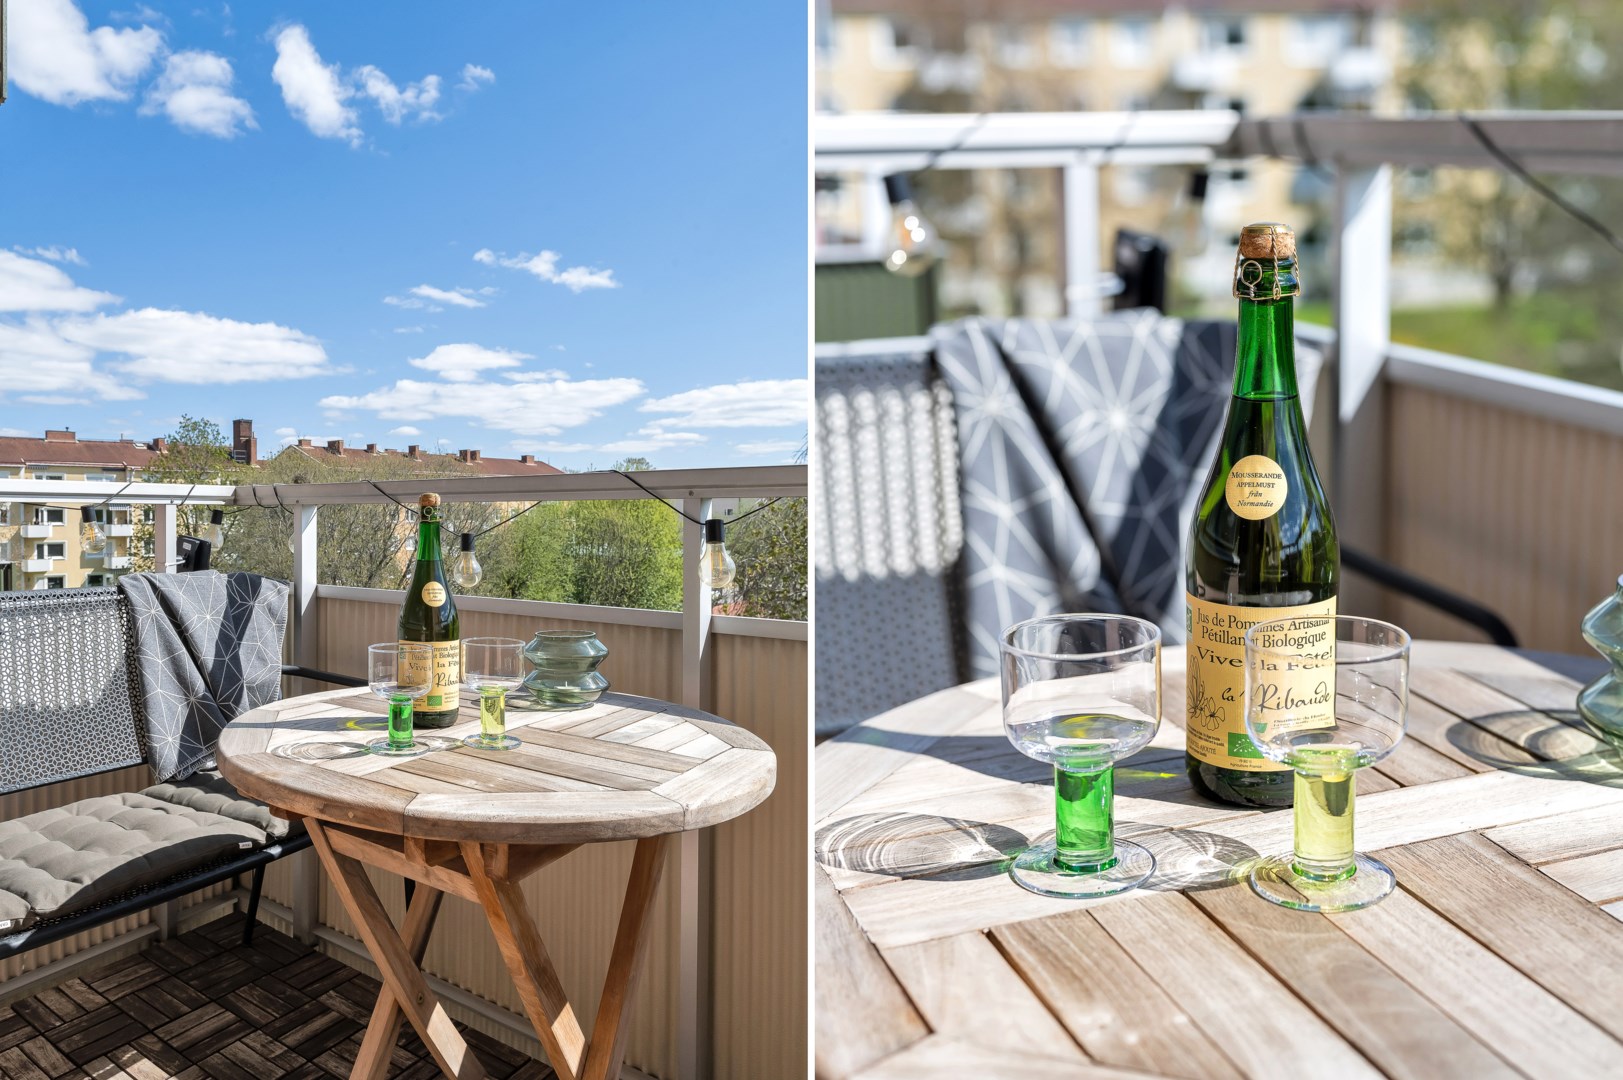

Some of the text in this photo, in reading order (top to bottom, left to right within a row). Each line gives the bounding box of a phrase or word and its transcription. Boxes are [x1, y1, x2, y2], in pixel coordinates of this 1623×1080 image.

[1196, 608, 1210, 624] Jus
[1211, 613, 1225, 627] de
[1201, 625, 1327, 650] Pétillant Biologique
[1195, 645, 1243, 668] Vive
[1260, 659, 1279, 671] la
[1251, 681, 1332, 714] Ribaude
